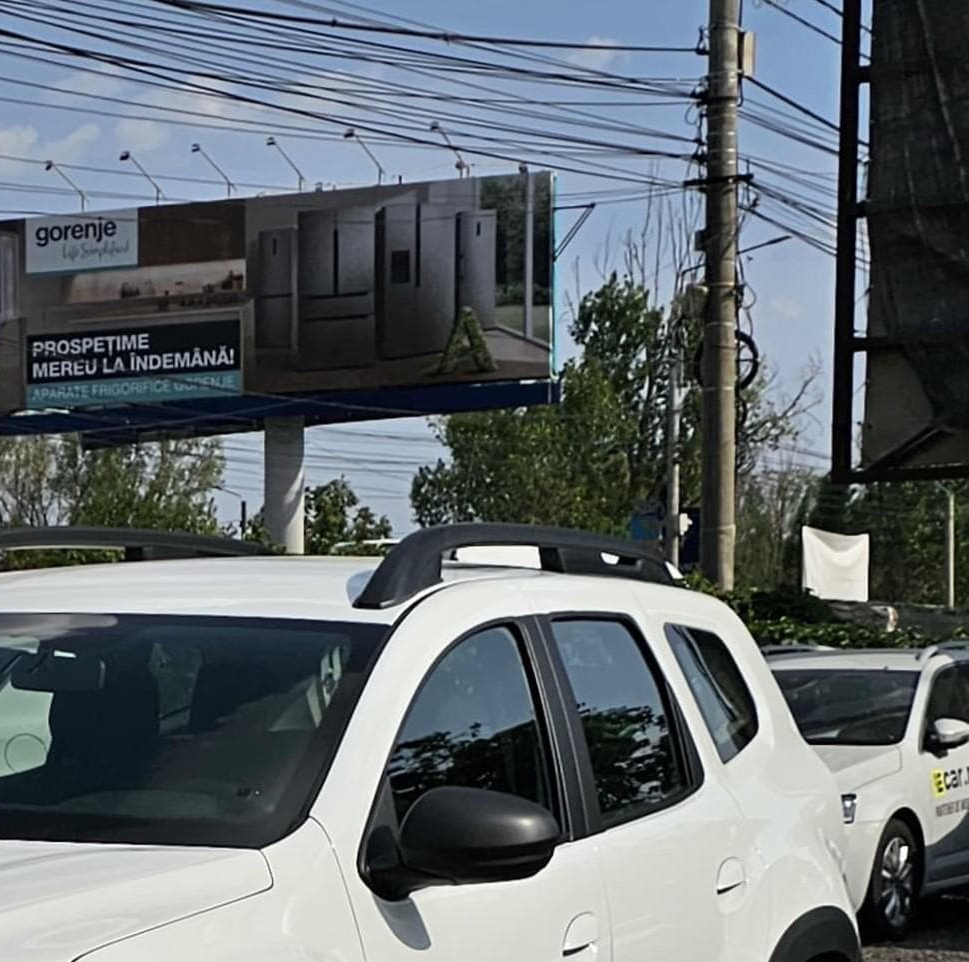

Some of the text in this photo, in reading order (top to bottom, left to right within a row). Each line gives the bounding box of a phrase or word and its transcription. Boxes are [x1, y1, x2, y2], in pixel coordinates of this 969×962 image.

[35, 217, 117, 247] gorenje
[32, 345, 235, 379] MEREU LA ÎNDEMÂNĂ!
[92, 379, 170, 397] FRIGORIFICE
